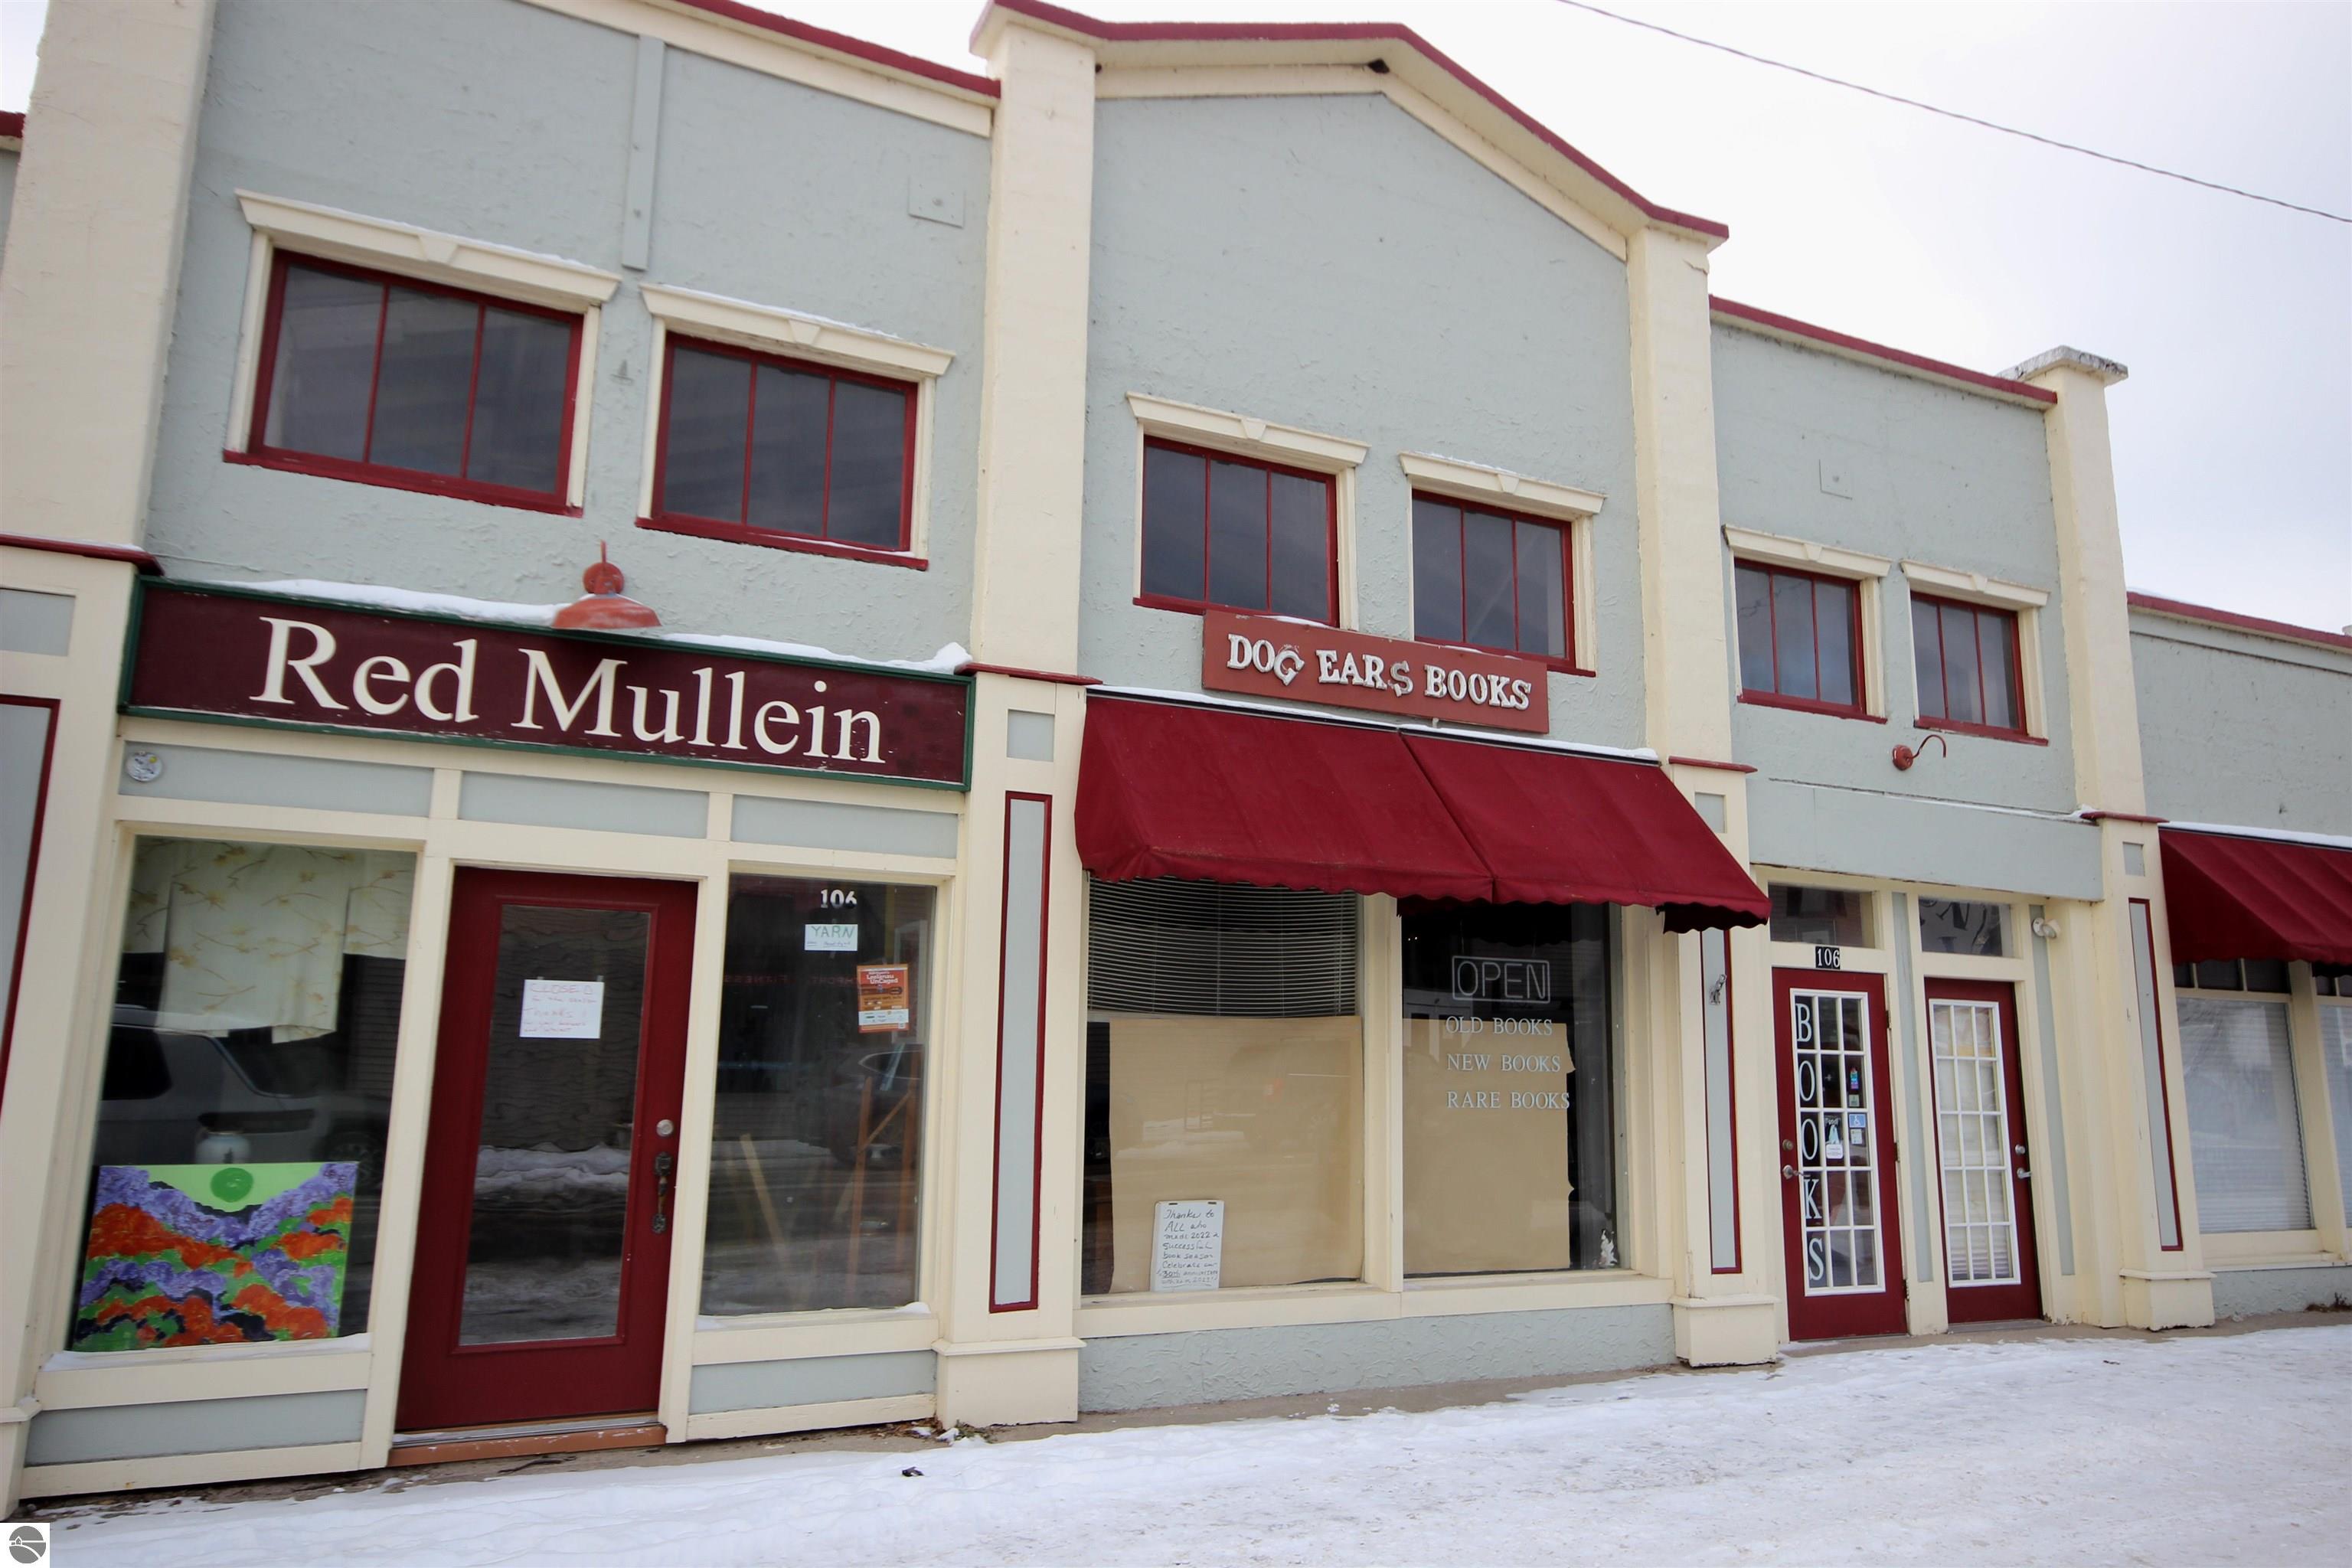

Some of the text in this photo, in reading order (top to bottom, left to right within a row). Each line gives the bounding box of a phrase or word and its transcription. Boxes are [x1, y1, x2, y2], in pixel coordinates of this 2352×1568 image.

[1227, 632, 1531, 710] DOG EARS BOOKS
[249, 616, 887, 764] Red Mullein
[820, 888, 858, 910] 106
[811, 925, 856, 939] YARN
[1815, 946, 1841, 969] 106
[1457, 960, 1547, 1000] OPEN
[1446, 1015, 1553, 1036] OLD BOOKS
[1446, 1054, 1560, 1073] NEW BOOKS
[1446, 1091, 1570, 1109] RARE BOOKS
[1795, 1002, 1825, 1282] BOOKS
[1164, 1208, 1214, 1219] Thanks to
[1165, 1220, 1207, 1233] ALL who
